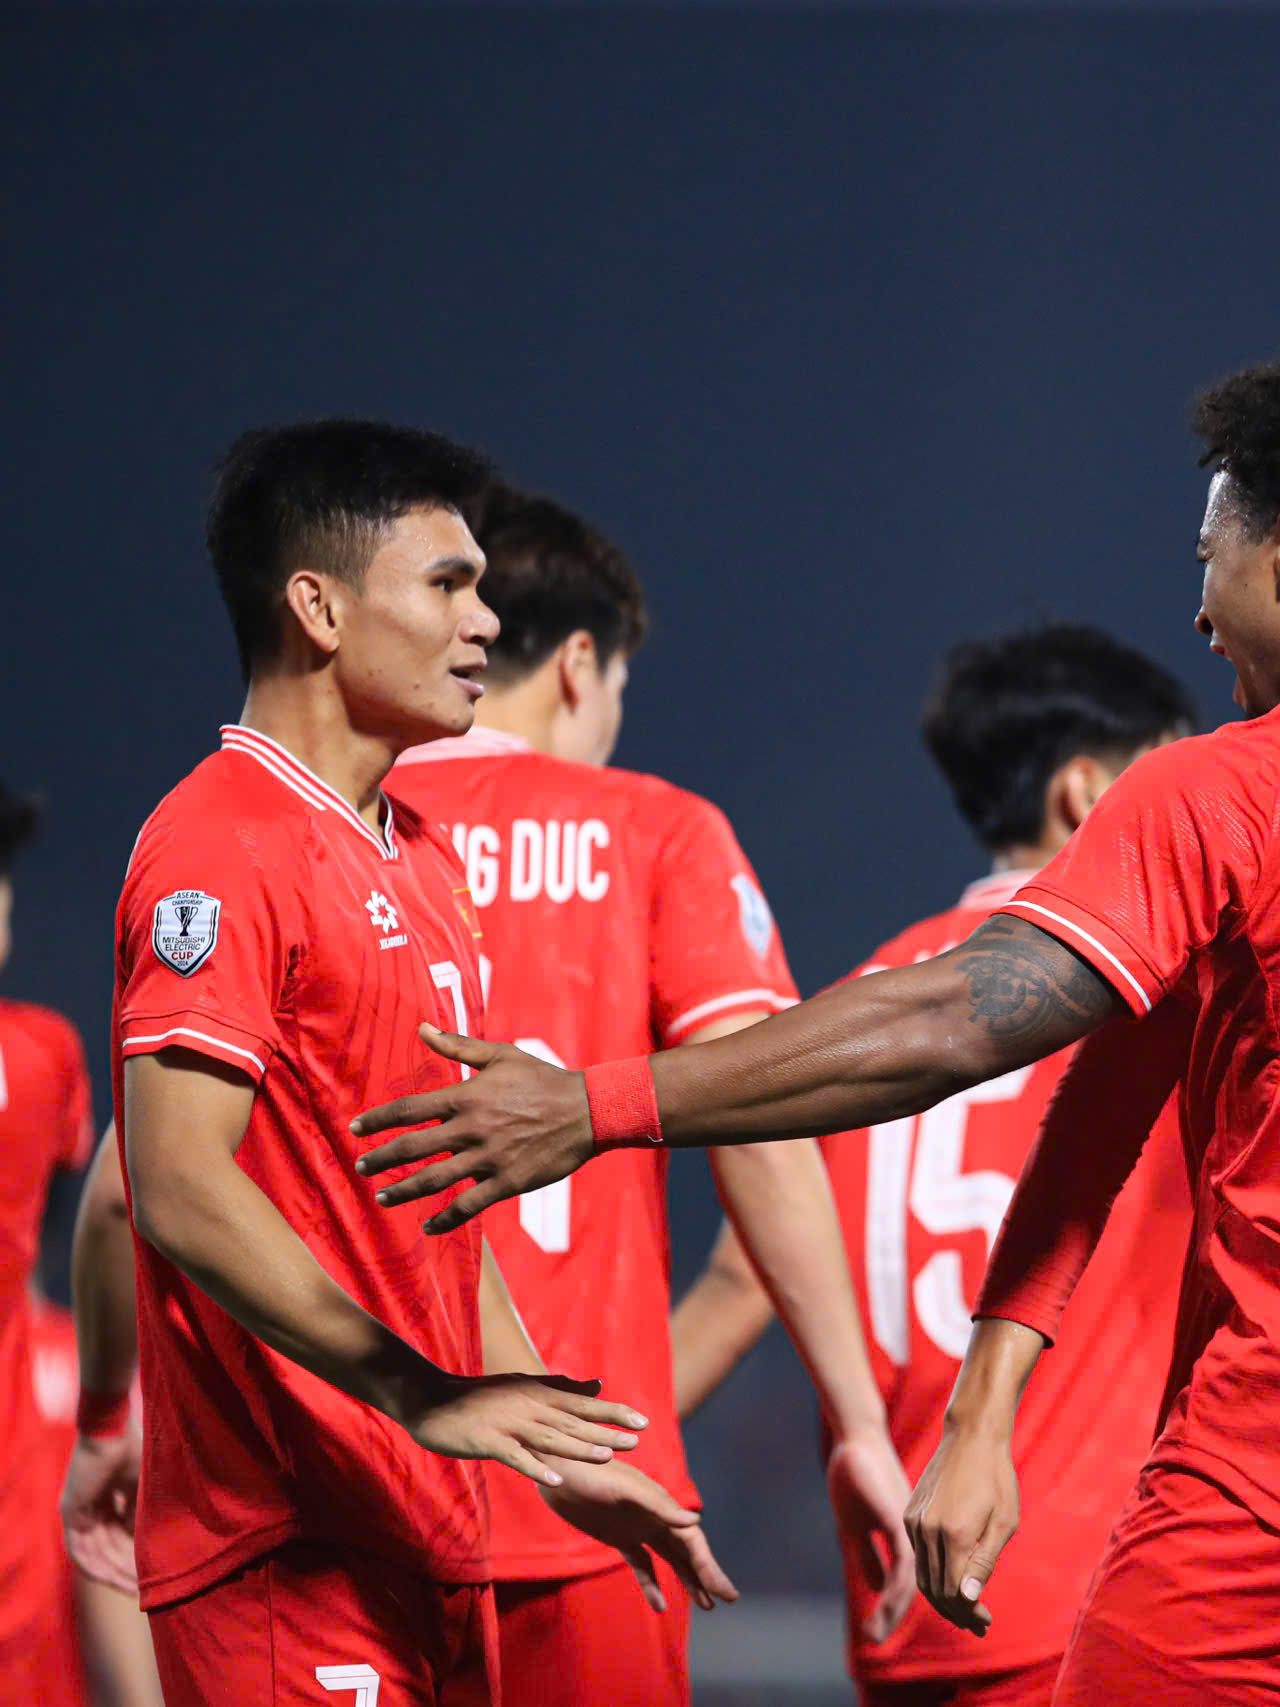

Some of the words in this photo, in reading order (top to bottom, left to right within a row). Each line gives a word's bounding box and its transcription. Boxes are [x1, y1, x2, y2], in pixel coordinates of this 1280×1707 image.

[509, 817, 611, 904] DUC
[165, 943, 200, 951] ELECTRIC
[171, 952, 193, 960] CUP
[429, 960, 470, 1083] 7
[865, 1063, 1036, 1367] 15
